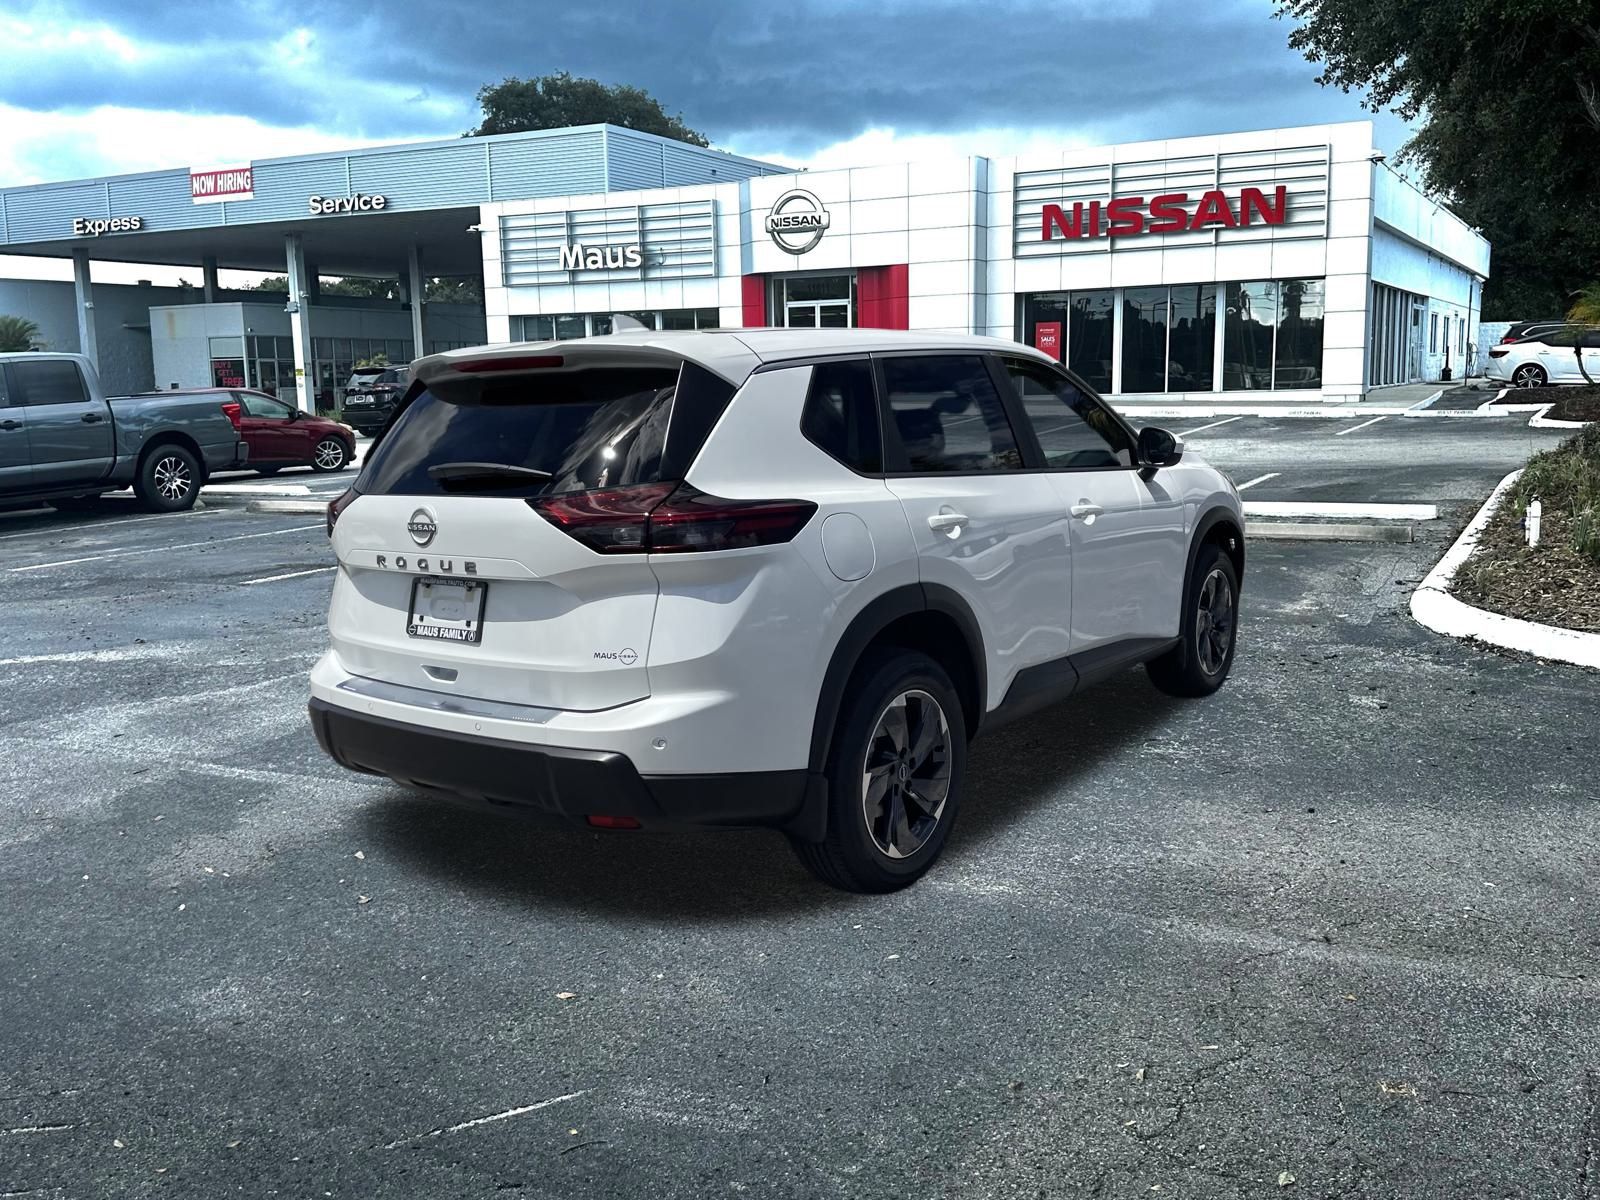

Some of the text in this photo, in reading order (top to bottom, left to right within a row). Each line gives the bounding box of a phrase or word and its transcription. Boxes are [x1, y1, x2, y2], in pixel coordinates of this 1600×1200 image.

[192, 171, 251, 195] NOW HIRING
[309, 193, 385, 215] Service
[1042, 185, 1286, 241] NISSAN
[73, 216, 141, 237] Express
[770, 214, 822, 230] NISSAN
[559, 243, 642, 270] Maus
[214, 361, 227, 369] BUY
[217, 369, 229, 377] GET
[223, 377, 244, 387] FREE
[376, 555, 477, 574] ROGUE
[416, 625, 468, 640] MAUS FAMILY
[593, 652, 618, 660] MAUS
